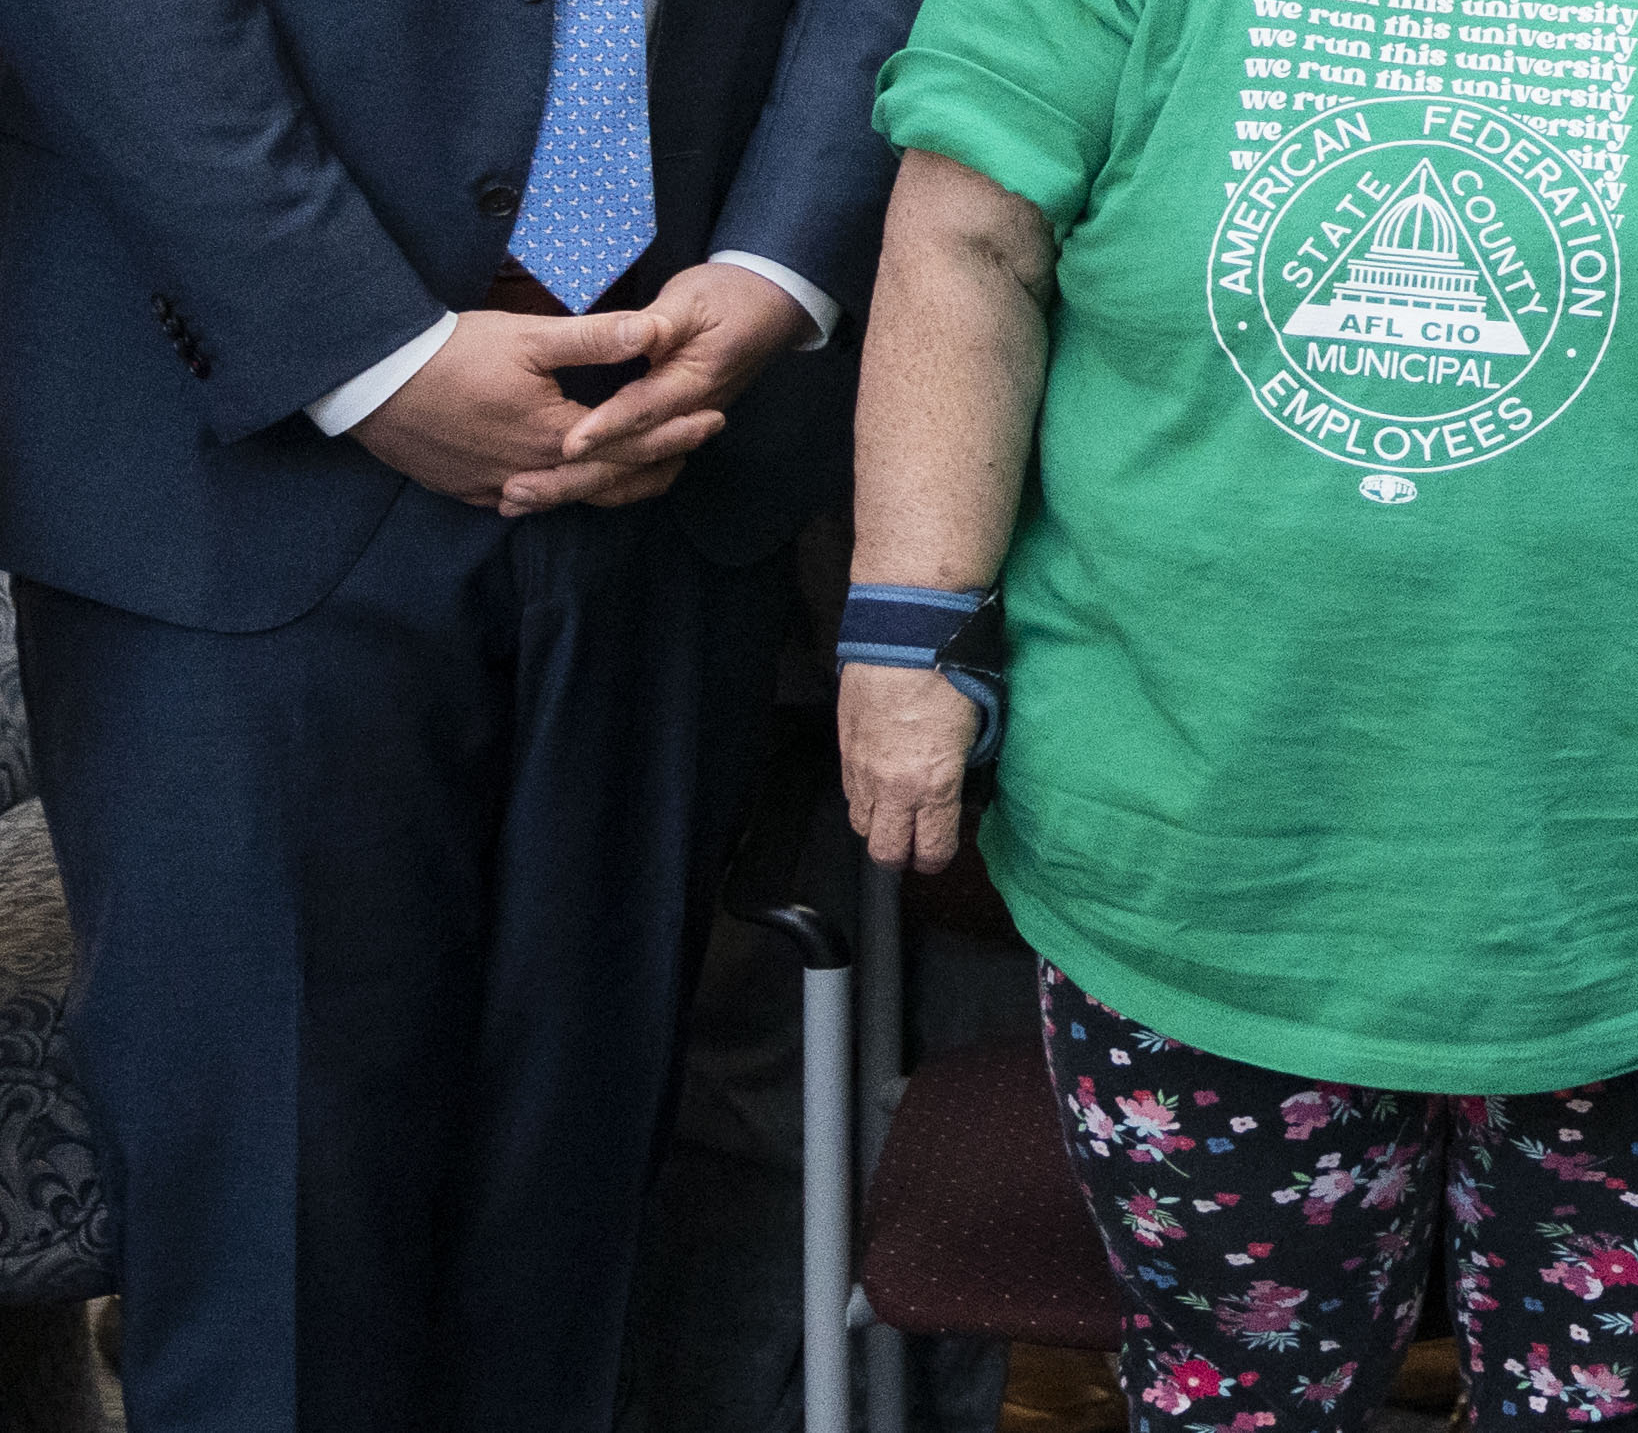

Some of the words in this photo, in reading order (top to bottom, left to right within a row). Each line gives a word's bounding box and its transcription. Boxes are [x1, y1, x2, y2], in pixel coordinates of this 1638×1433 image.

[1248, 27, 1297, 48] we
[1302, 34, 1372, 60] run
[1378, 42, 1448, 66] this
[1454, 50, 1637, 93] university
[1308, 8, 1376, 33] run
[1383, 14, 1451, 40] this
[1458, 23, 1638, 63] university
[1239, 89, 1288, 110] we
[1292, 91, 1356, 112] ru
[1244, 58, 1292, 79] we
[1297, 61, 1367, 87] run
[1374, 69, 1444, 93] this
[1451, 77, 1635, 122] university
[1235, 120, 1282, 141] we
[1219, 112, 1372, 295] AMERICAN
[1424, 105, 1608, 317] FEDERATION
[1282, 170, 1391, 289] STATE
[1452, 169, 1549, 316] COUNTY
[1338, 314, 1404, 339] AFL
[1421, 321, 1481, 344] CIO
[1306, 342, 1501, 390] MUNICIPAL
[1259, 369, 1533, 462] EMPLOYEES
